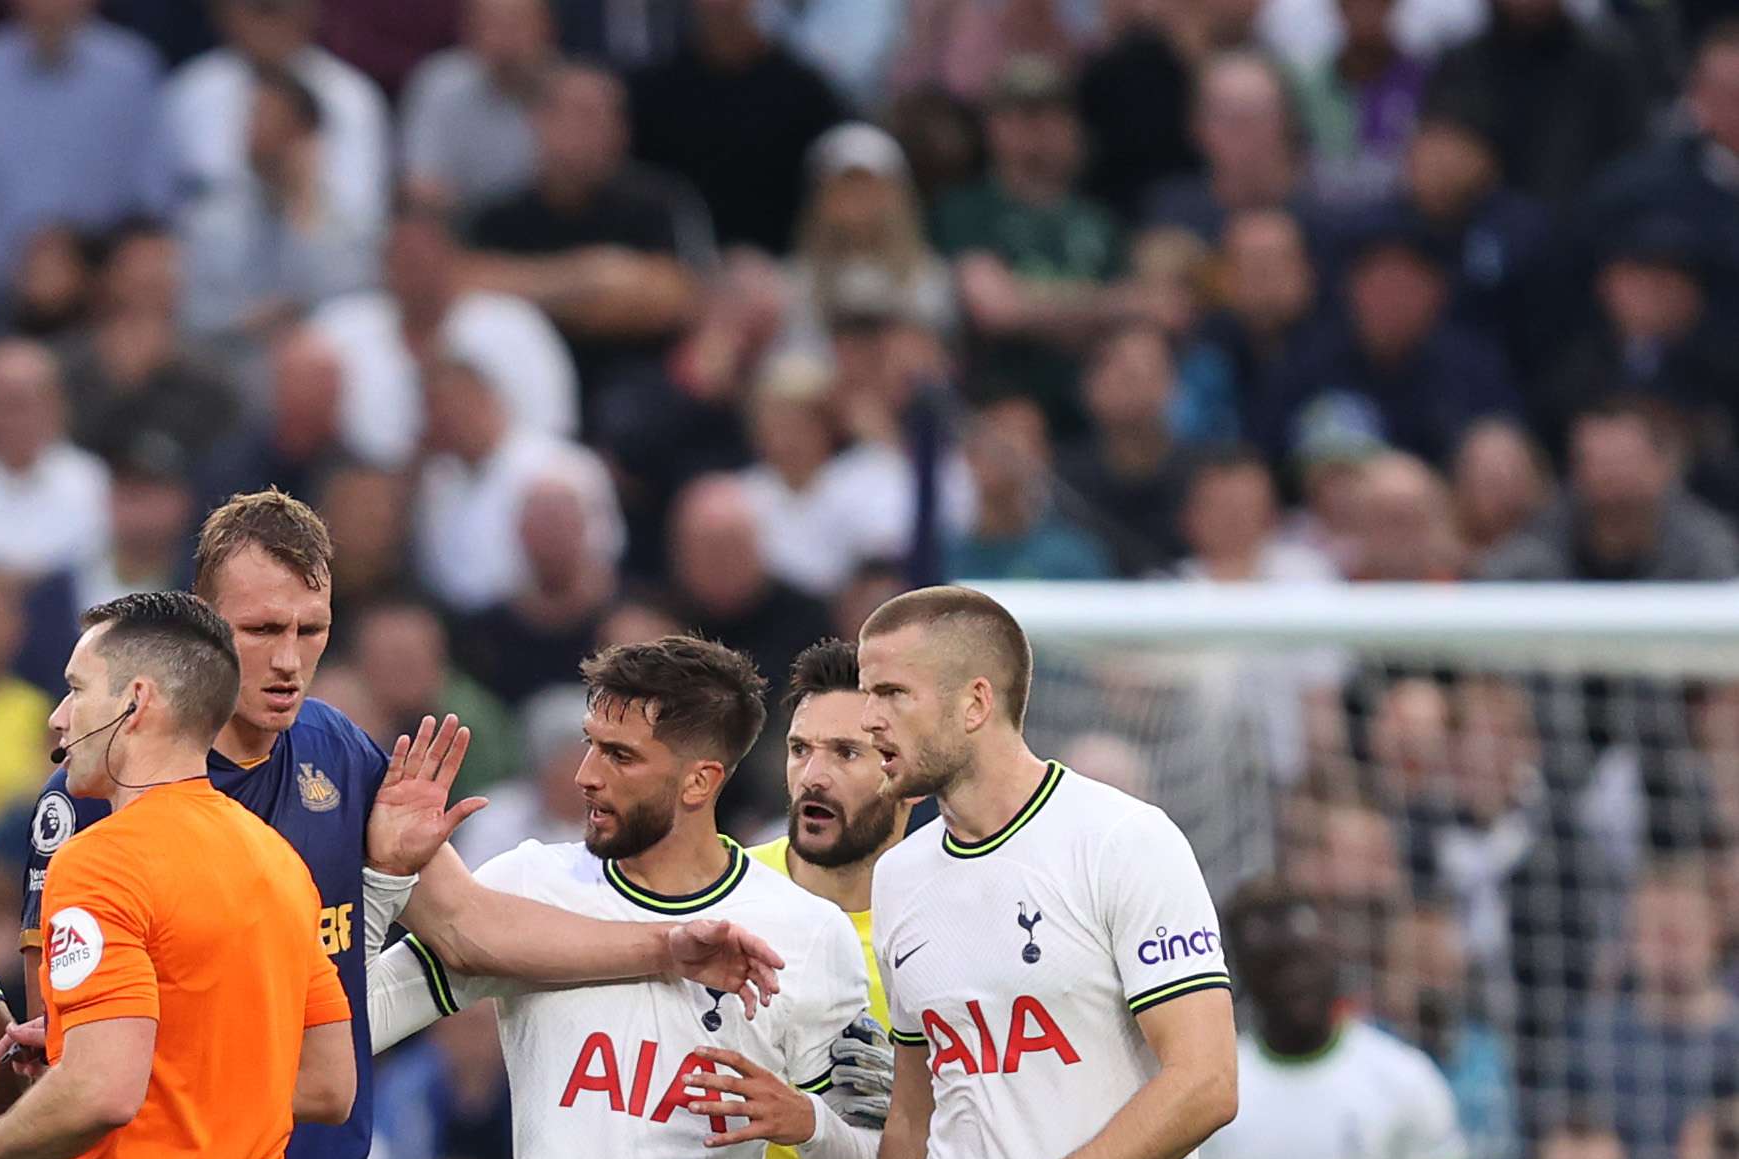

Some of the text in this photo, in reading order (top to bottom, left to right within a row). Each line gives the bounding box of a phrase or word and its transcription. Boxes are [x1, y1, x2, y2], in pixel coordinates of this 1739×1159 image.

[51, 925, 88, 957] EA
[1137, 925, 1221, 966] cinch
[921, 994, 1083, 1080] AIA
[559, 1031, 728, 1134] AIA
